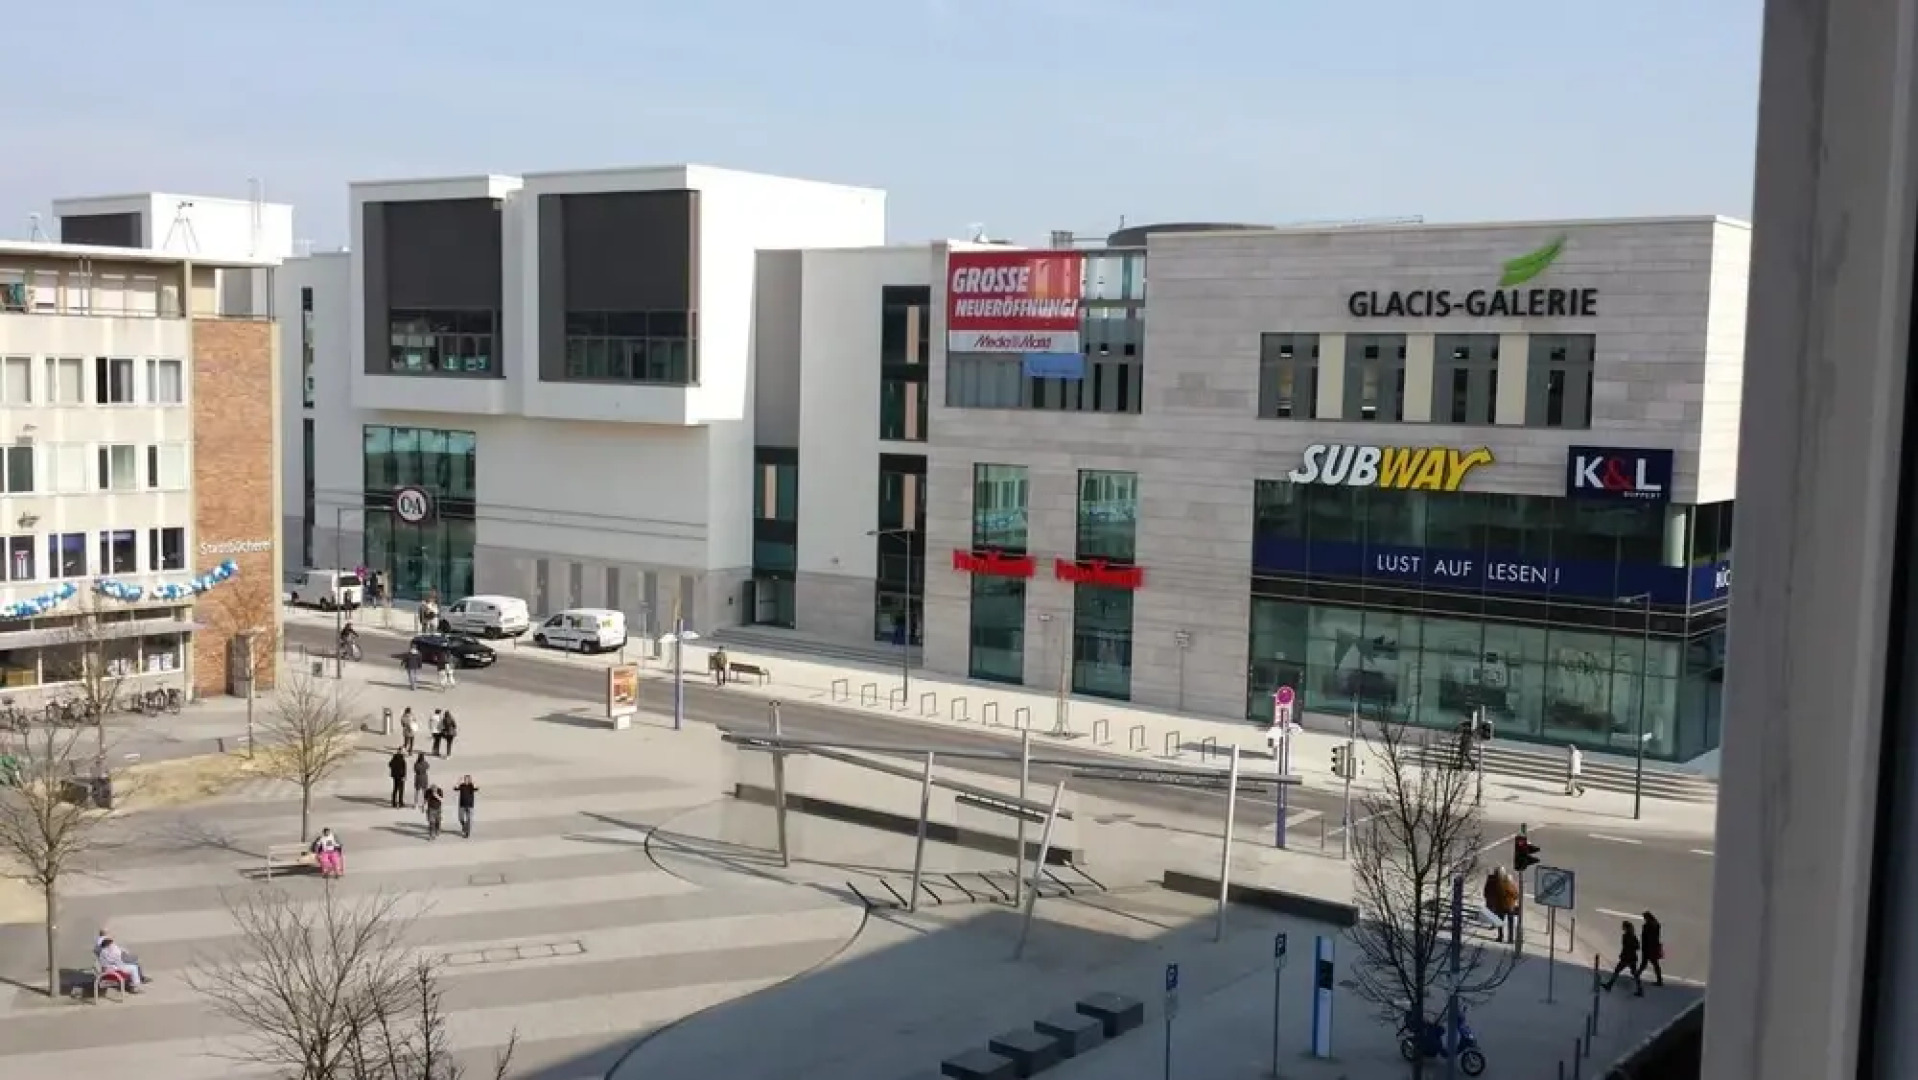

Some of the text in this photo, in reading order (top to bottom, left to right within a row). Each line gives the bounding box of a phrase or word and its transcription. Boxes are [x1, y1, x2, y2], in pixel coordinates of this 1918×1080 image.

[953, 266, 1030, 293] GROSSE
[955, 296, 1079, 318] NEUERÖFFNUNG!
[1348, 287, 1599, 318] GLACIS-GALERIE
[1289, 444, 1494, 491] SUBWAY
[1575, 455, 1662, 491] K&L
[1377, 554, 1420, 573] LUST
[1434, 559, 1473, 577] AUF
